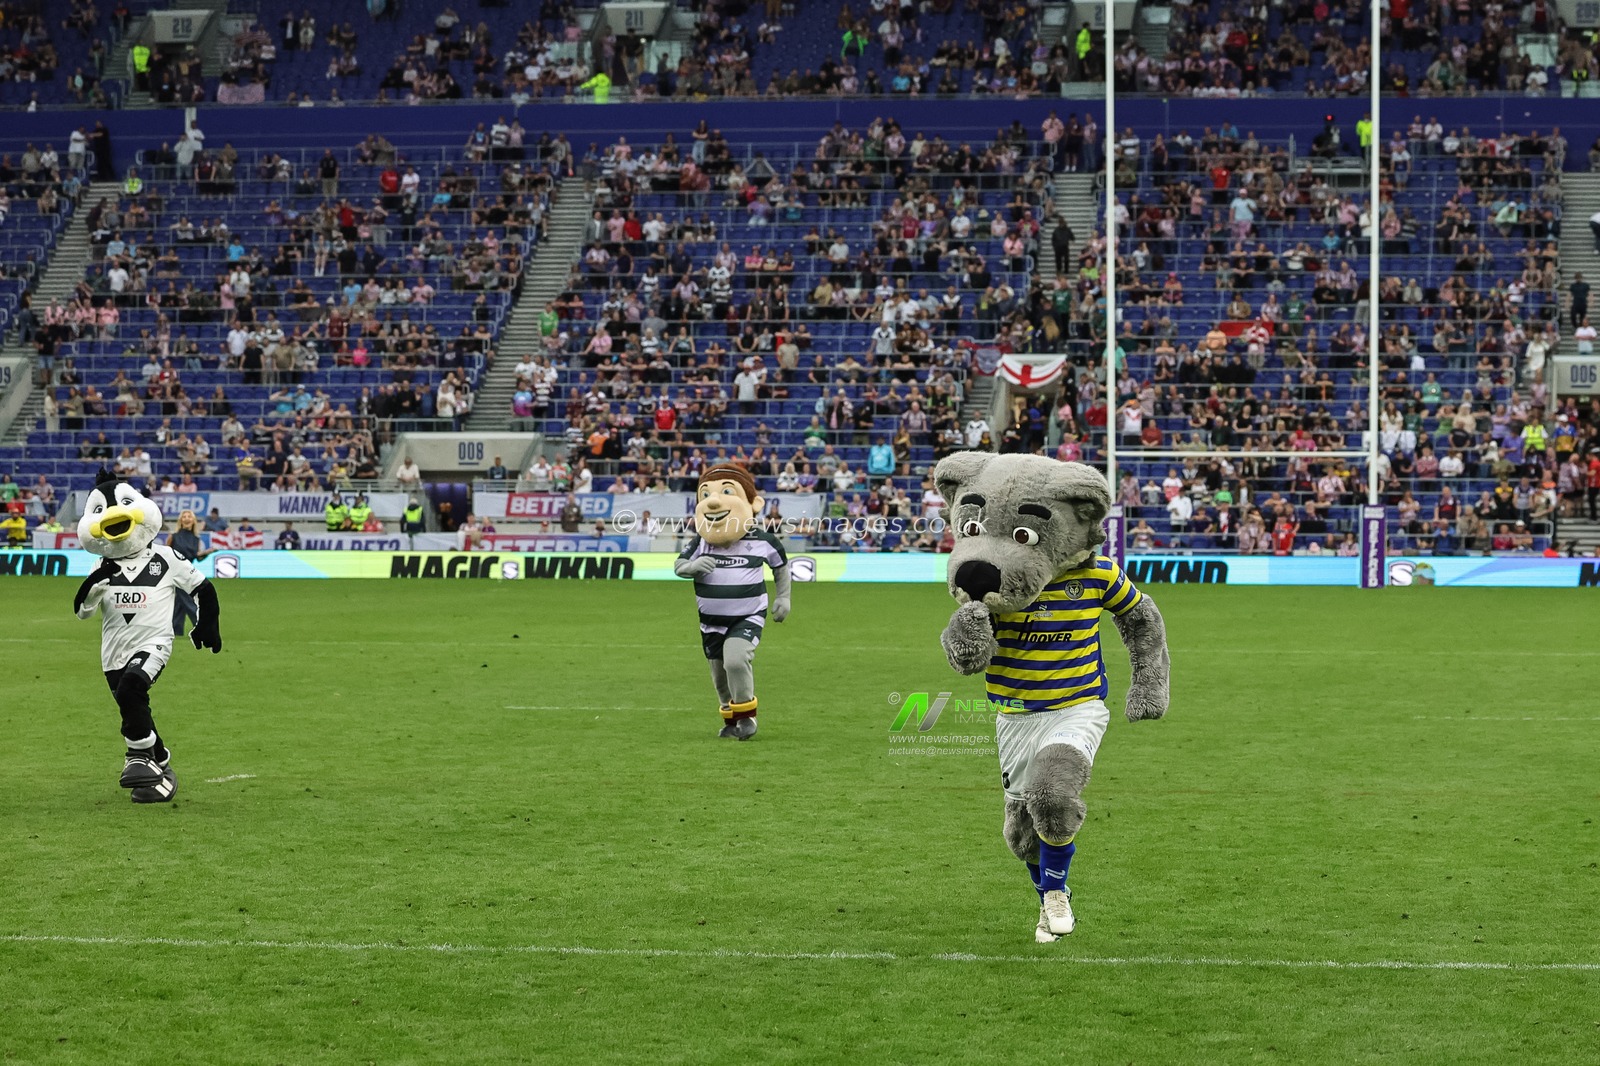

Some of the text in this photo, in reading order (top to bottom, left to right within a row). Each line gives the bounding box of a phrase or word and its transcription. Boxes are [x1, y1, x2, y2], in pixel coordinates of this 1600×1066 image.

[172, 17, 192, 33] 212
[625, 10, 644, 26] 211
[1571, 365, 1597, 383] 006
[459, 442, 484, 460] 008
[510, 497, 609, 514] BETFED
[0, 554, 68, 576] KND
[391, 556, 499, 579] MAGIC
[524, 557, 635, 579] WKND
[1018, 614, 1073, 646] HOOVER
